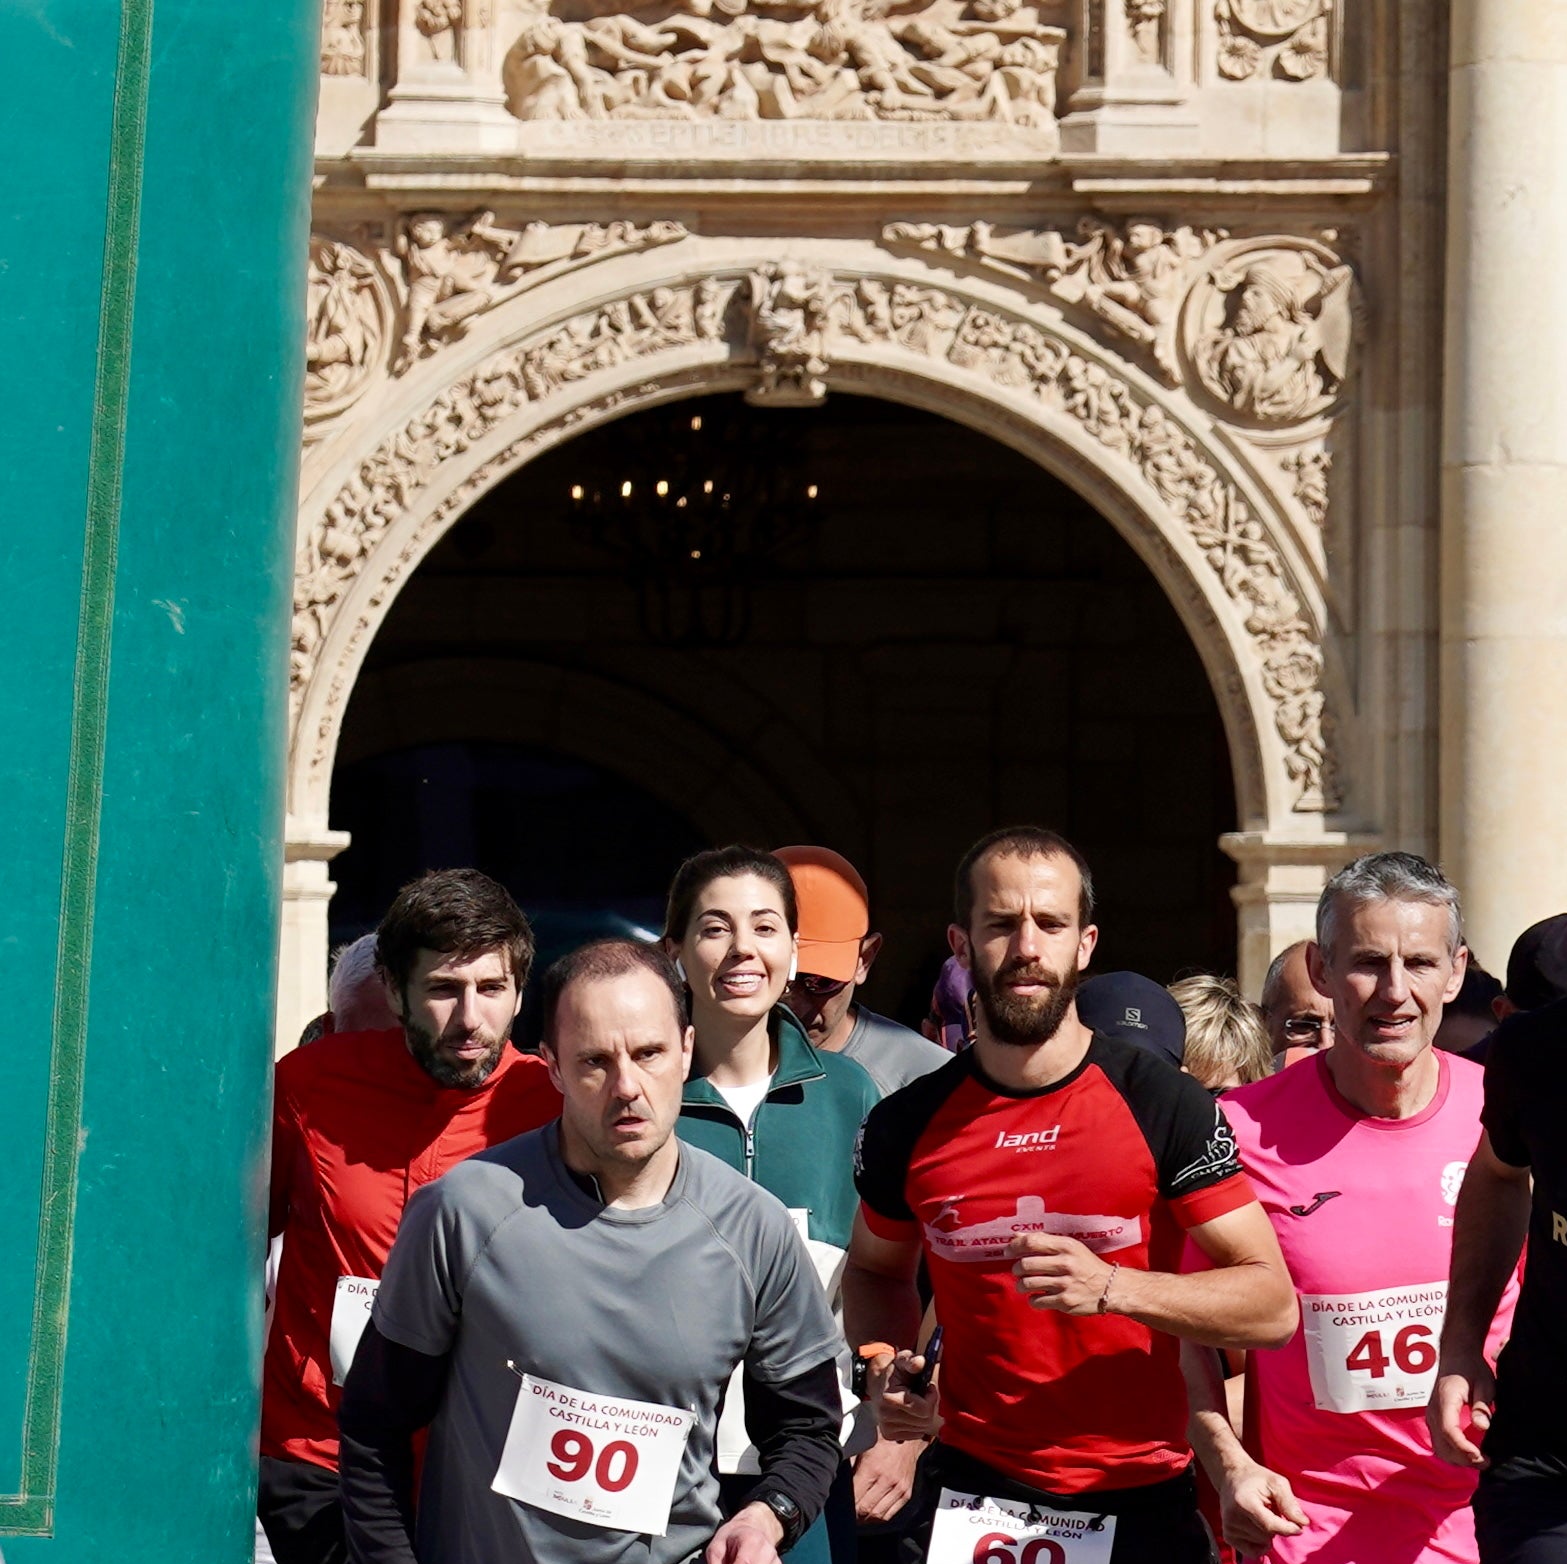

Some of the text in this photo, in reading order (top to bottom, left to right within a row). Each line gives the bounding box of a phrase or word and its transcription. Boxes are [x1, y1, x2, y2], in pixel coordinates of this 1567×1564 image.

[1011, 1222, 1045, 1232] CXM
[935, 1236, 966, 1247] TRAIL
[347, 1283, 368, 1297] DÍA
[1312, 1291, 1448, 1313] DÍA DE LA COMUNID
[1332, 1305, 1443, 1327] CASTILLA Y LEÓN
[1346, 1324, 1437, 1379] 46
[533, 1385, 683, 1426] DÍA DE LA COMUNIDAD
[549, 1407, 659, 1437] CASTILLA Y LEÓN
[547, 1429, 639, 1493] 90
[1035, 1526, 1041, 1534] Y
[1045, 1527, 1082, 1540] LEÓN
